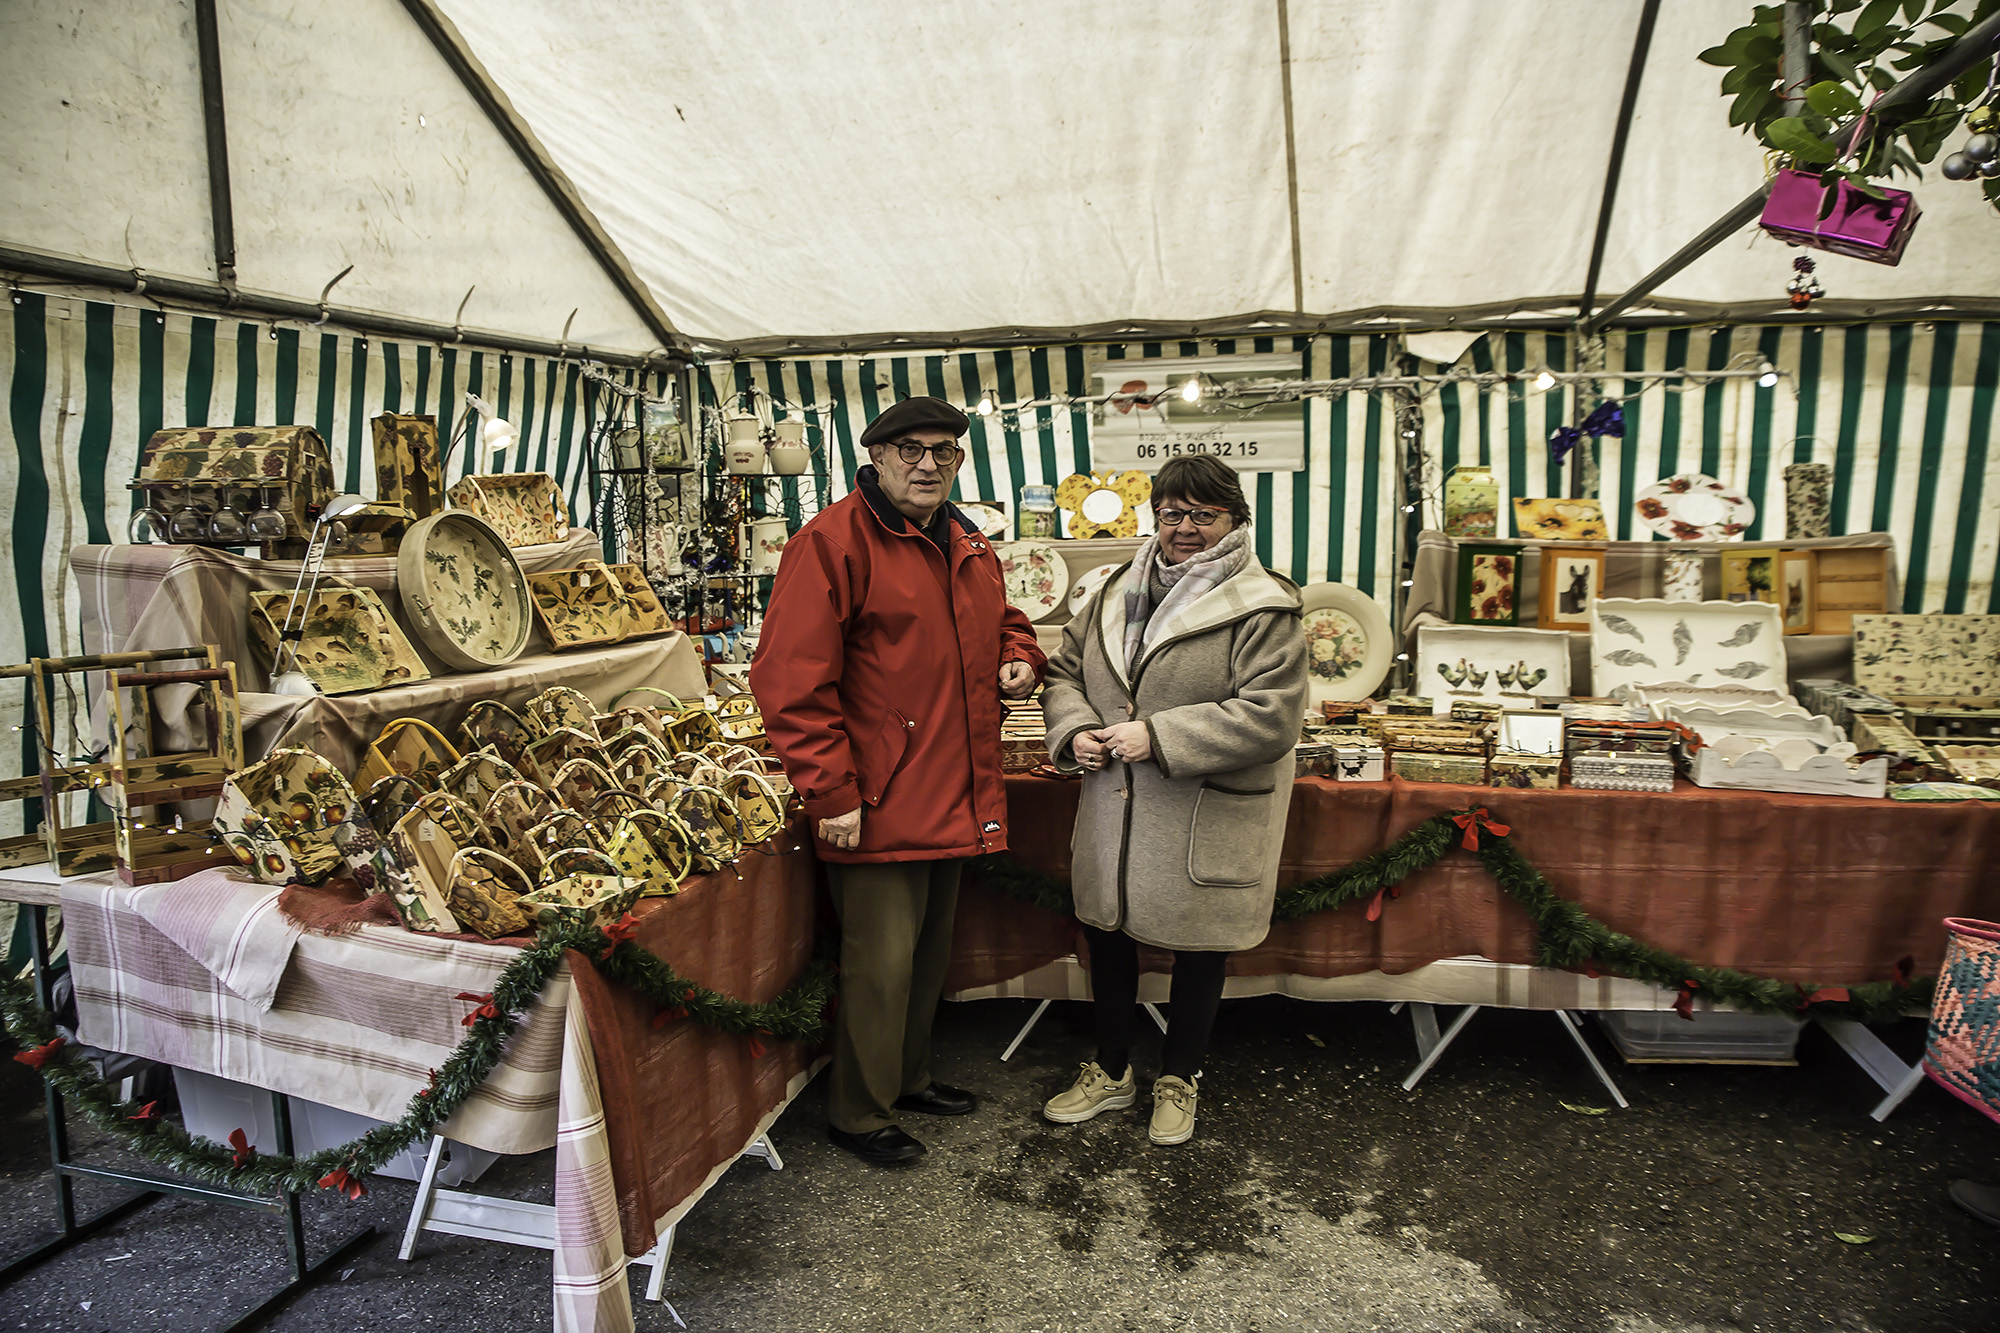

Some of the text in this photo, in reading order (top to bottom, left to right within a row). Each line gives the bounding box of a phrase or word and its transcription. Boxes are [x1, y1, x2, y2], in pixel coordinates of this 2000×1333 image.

[1137, 441, 1258, 458] 06 15 90 32 15
